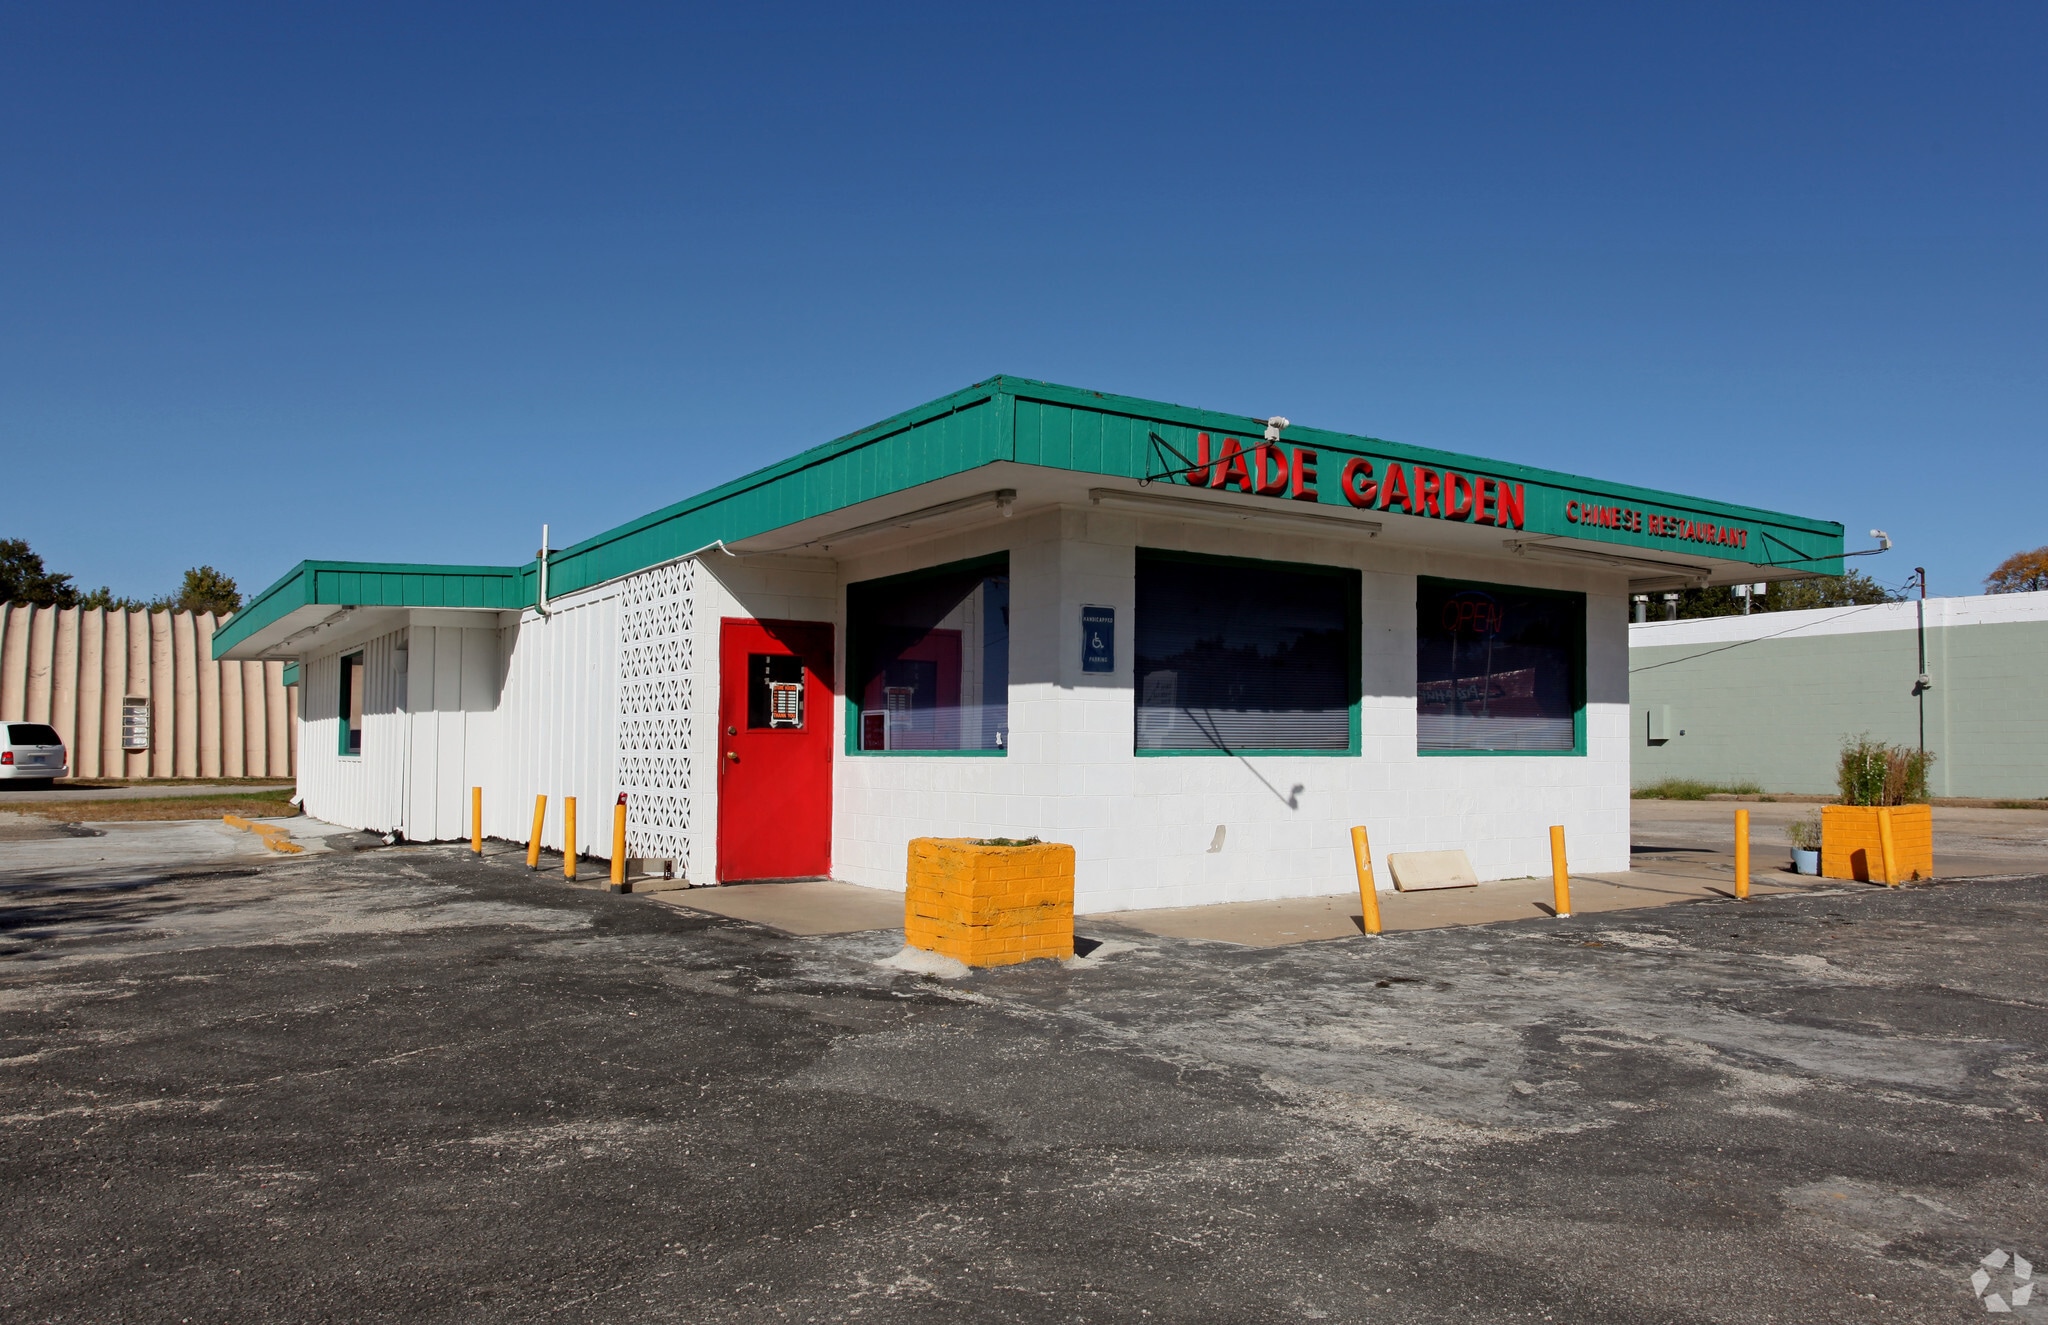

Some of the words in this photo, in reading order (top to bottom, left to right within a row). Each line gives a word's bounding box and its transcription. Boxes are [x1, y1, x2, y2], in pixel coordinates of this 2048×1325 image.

[1186, 432, 1318, 502] JADE
[1342, 457, 1524, 529] GARDEN
[1566, 500, 1642, 532] CHINESE
[1648, 514, 1747, 549] RESTAURANT
[1442, 600, 1503, 632] OPEN
